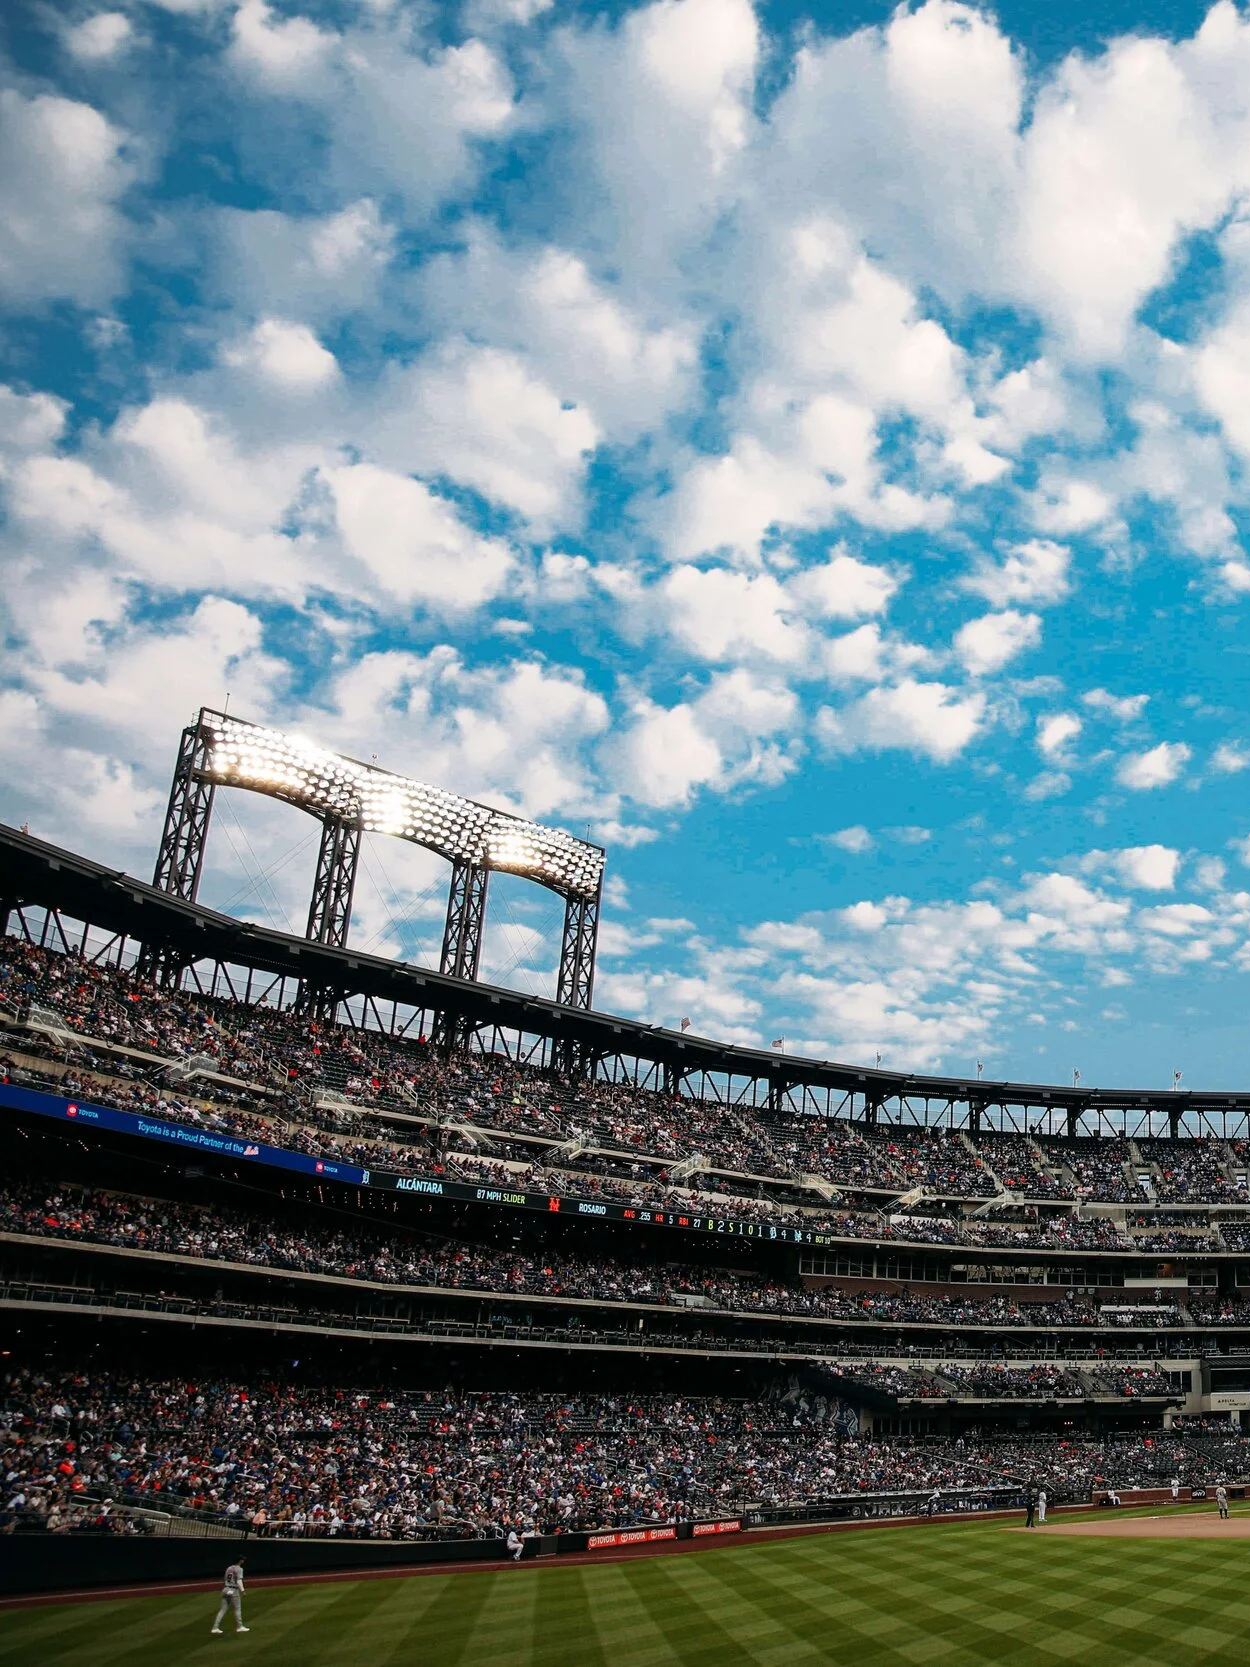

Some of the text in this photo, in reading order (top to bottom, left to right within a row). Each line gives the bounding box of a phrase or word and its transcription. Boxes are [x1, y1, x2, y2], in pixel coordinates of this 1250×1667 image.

[78, 1108, 99, 1119] TOYOTA
[138, 1121, 161, 1134] Toyota
[163, 1126, 169, 1137] is
[170, 1130, 176, 1138] a
[177, 1130, 199, 1143] Proud
[199, 1135, 224, 1149] Partner
[224, 1142, 232, 1150] of
[232, 1143, 244, 1153] the
[396, 1178, 443, 1194] ALCÁNTARA
[477, 1188, 526, 1205] 87 MPH SLIDER
[579, 1203, 606, 1215] ROSARIO
[623, 1210, 636, 1219] AVG
[638, 1211, 651, 1221] .255
[655, 1214, 664, 1223] HR
[668, 1215, 674, 1225] 5
[678, 1217, 689, 1226] RBI
[693, 1218, 701, 1228] 27
[708, 1219, 714, 1230] B
[717, 1221, 725, 1233] 2
[728, 1222, 734, 1233] S
[738, 1223, 744, 1235] 1
[757, 1226, 762, 1237] 1
[781, 1229, 787, 1240] 4
[806, 1232, 812, 1243] 4
[815, 1235, 824, 1244] BOT
[699, 1524, 716, 1534] TOYOTA
[724, 1521, 740, 1531] TOYOTA
[628, 1531, 646, 1541] TOYOTA
[657, 1528, 675, 1538] TOYOTA
[597, 1534, 616, 1545] TOYOTA
